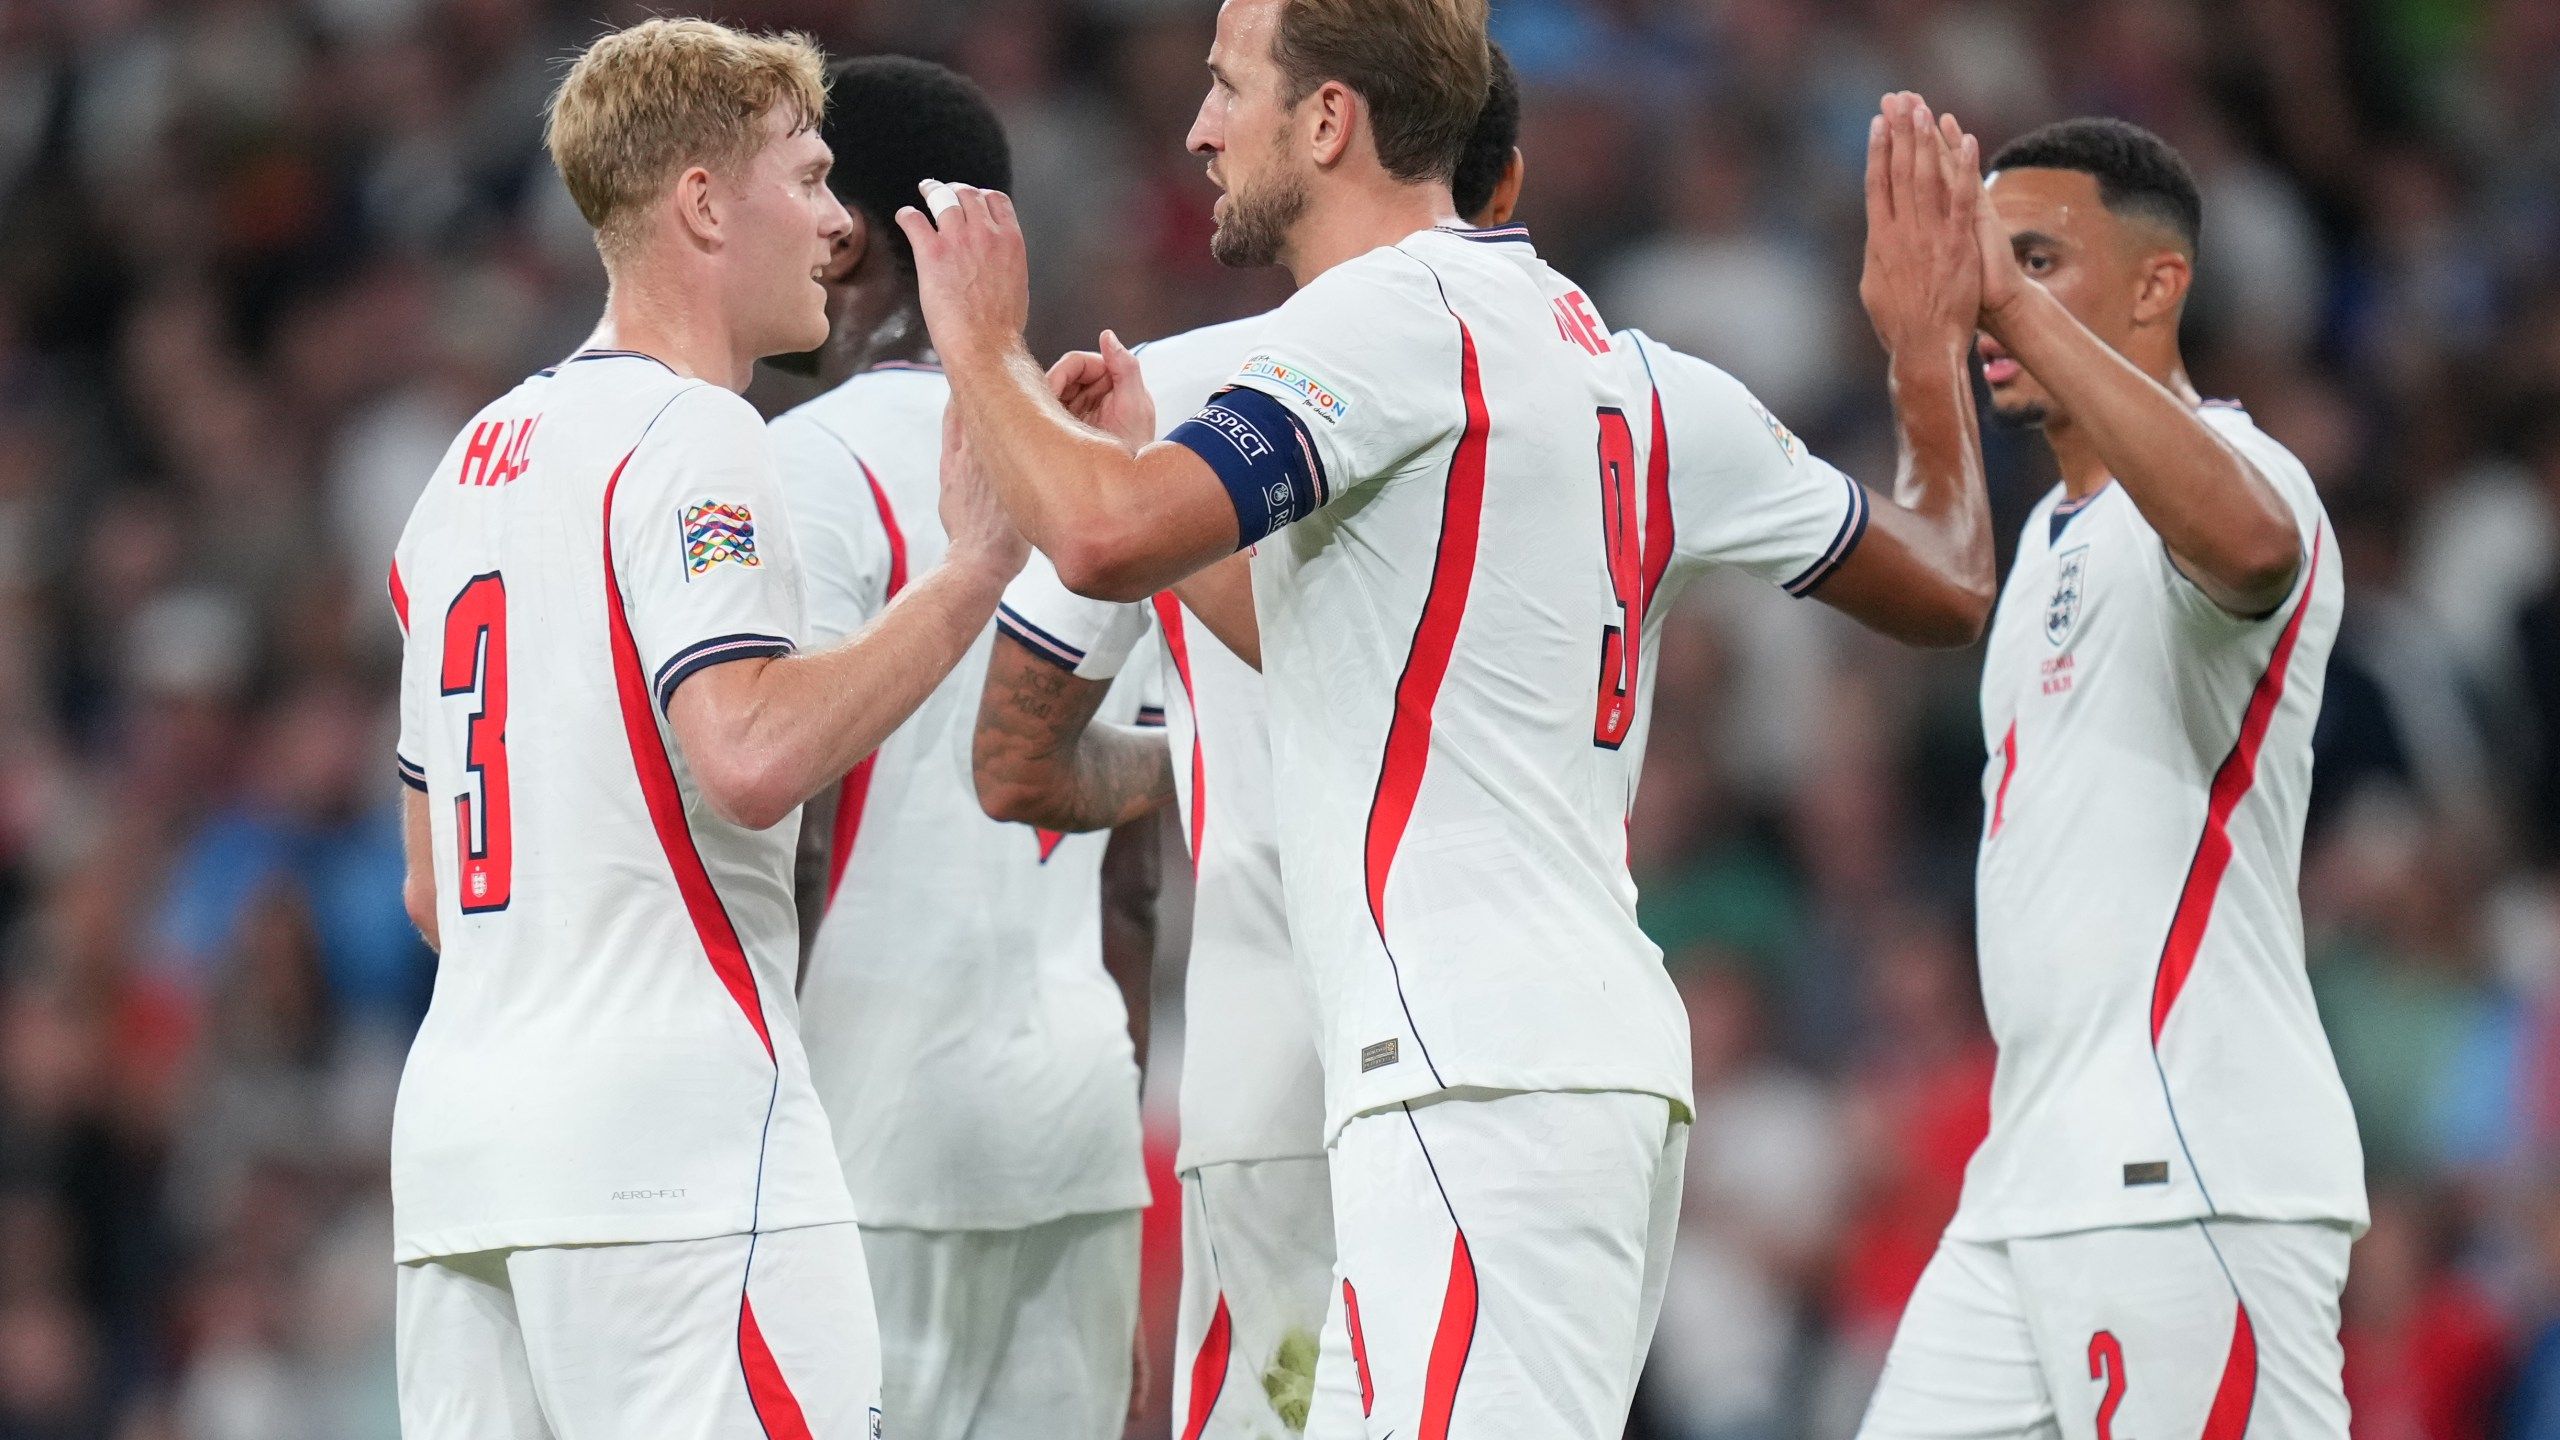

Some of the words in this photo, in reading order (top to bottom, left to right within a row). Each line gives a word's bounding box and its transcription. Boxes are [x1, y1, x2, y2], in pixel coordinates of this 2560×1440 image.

[458, 411, 543, 486] HALL
[1194, 409, 1269, 457] RESPECT
[1270, 508, 1290, 534] RE
[1593, 405, 1642, 751] 9
[440, 569, 513, 916] 3
[2087, 1328, 2128, 1440] 2
